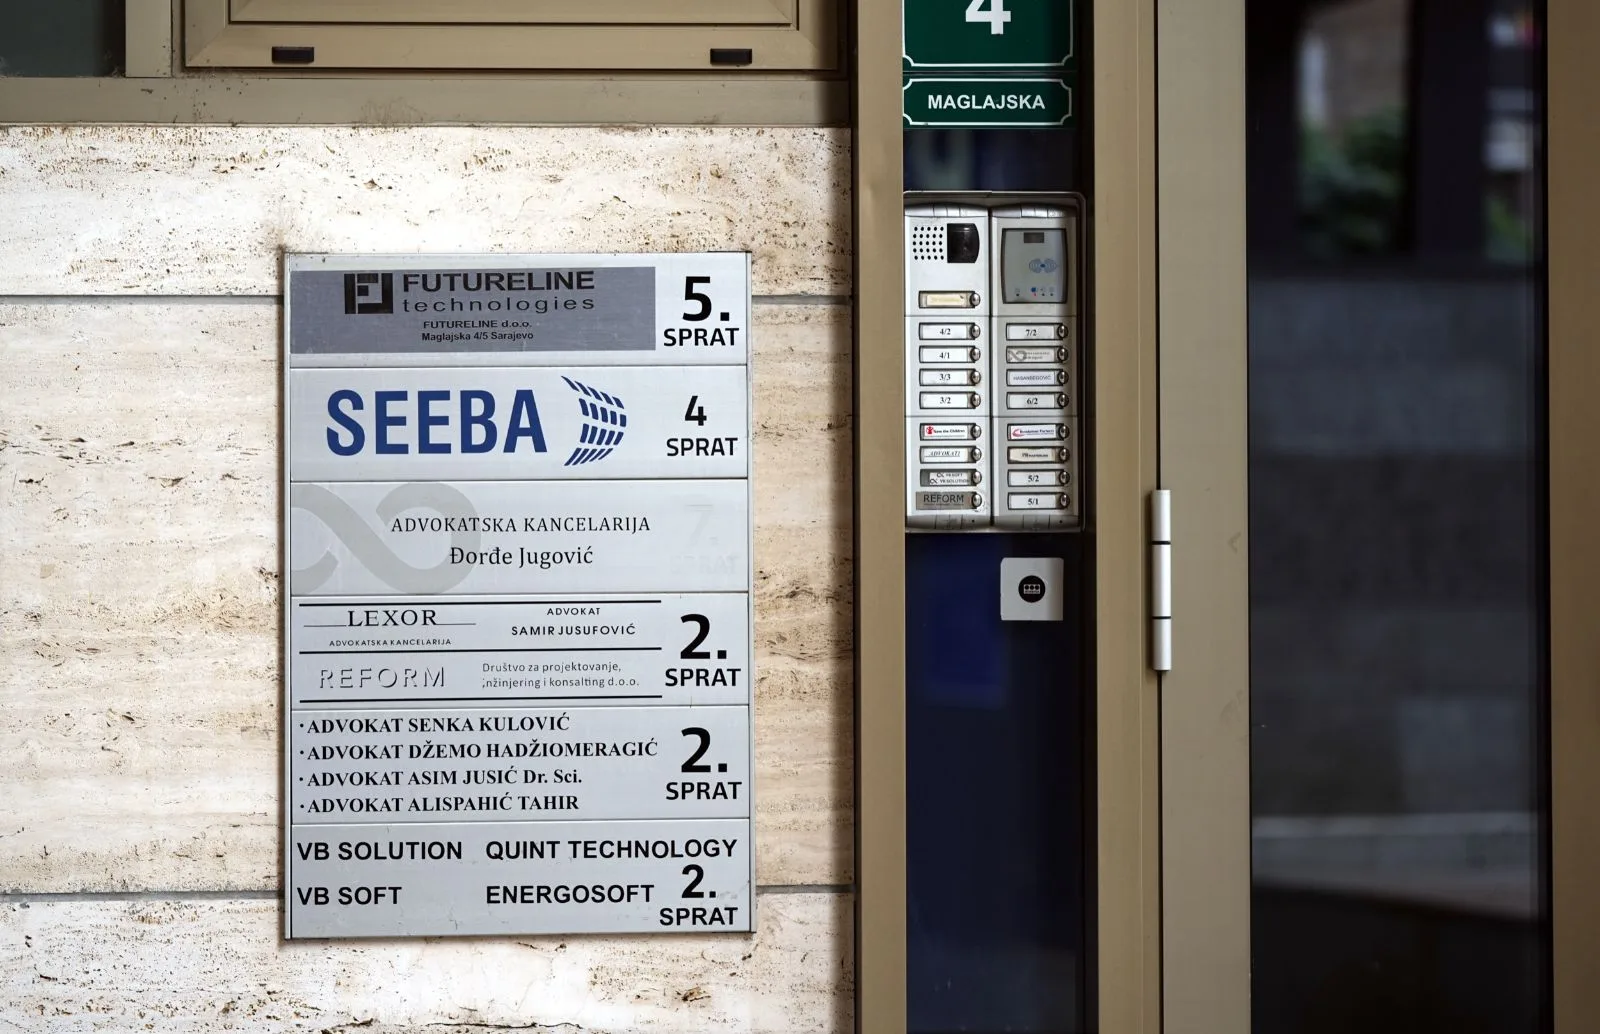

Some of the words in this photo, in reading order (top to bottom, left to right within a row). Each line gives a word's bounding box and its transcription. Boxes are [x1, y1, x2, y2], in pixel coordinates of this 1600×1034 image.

[965, 0, 1012, 35] 4
[927, 94, 1046, 110] MAGLAJSKA
[403, 270, 595, 292] FUTURELINE
[402, 297, 595, 313] technologies
[682, 276, 730, 322] 5.
[423, 320, 498, 329] FUTURELINE
[500, 319, 532, 328] d.o.o.
[939, 328, 952, 336] 4/2
[1025, 329, 1037, 337] 7/2
[421, 332, 470, 342] Maglajska
[474, 331, 489, 341] 4/5
[491, 330, 534, 341] Sarajevo
[663, 327, 739, 347] SPRAT
[939, 350, 951, 359] 4/1
[939, 373, 951, 381] 3/3
[939, 396, 952, 405] 3/2
[1026, 396, 1039, 405] 6/2
[684, 395, 707, 427] 4
[326, 389, 548, 456] SEEBA
[666, 437, 738, 457] SPRAT
[1027, 474, 1040, 483] 5/2
[923, 493, 965, 504] REFORM
[1027, 497, 1039, 506] 5/1
[391, 517, 518, 533] ADVOKATSKA
[523, 516, 651, 533] KANCELARIJA
[449, 546, 513, 565] Đorđe
[519, 545, 594, 569] Jugović
[347, 610, 438, 627] LEXOR
[546, 607, 602, 616] ADVOKAT
[511, 626, 555, 636] SAMIR
[557, 623, 637, 636] JUSUFOVIĆ
[679, 613, 728, 660] 2.
[389, 638, 452, 646] KANCELARIJA
[482, 663, 526, 673] Društvo
[529, 664, 540, 672] za
[542, 661, 622, 674] projektovanje,
[319, 666, 446, 689] REFORM
[549, 676, 605, 689] konsalting
[607, 676, 640, 687] d.o.o.
[664, 668, 741, 687] SPRAT
[306, 718, 404, 734] ADVOKAT
[407, 716, 474, 732] SENKA
[479, 712, 571, 732] KULOVIĆ
[306, 745, 404, 761] ADVOKAT
[408, 740, 482, 760] DŽEMO
[486, 739, 659, 758] HADŽIOMERAGIĆ
[680, 726, 728, 774] 2.
[306, 772, 404, 788] ADVOKAT
[407, 770, 458, 786] ASIM
[462, 765, 518, 786] JUSIĆ
[523, 768, 549, 785] Dr.
[553, 768, 583, 785] Sci.
[665, 781, 742, 800] SPRAT
[306, 798, 404, 814] ADVOKAT
[408, 792, 513, 813] ALISPAHIĆ
[517, 795, 579, 811] TAHIR
[297, 842, 330, 860] VB
[337, 841, 463, 860] SOLUTION
[485, 841, 562, 860] QUINT
[567, 838, 738, 859] TECHNOLOGY
[297, 887, 330, 905] VB
[337, 886, 403, 905] SOFT
[486, 884, 655, 904] ENERGOSOFT
[681, 864, 717, 899] 2.
[659, 907, 739, 926] SPRAT
